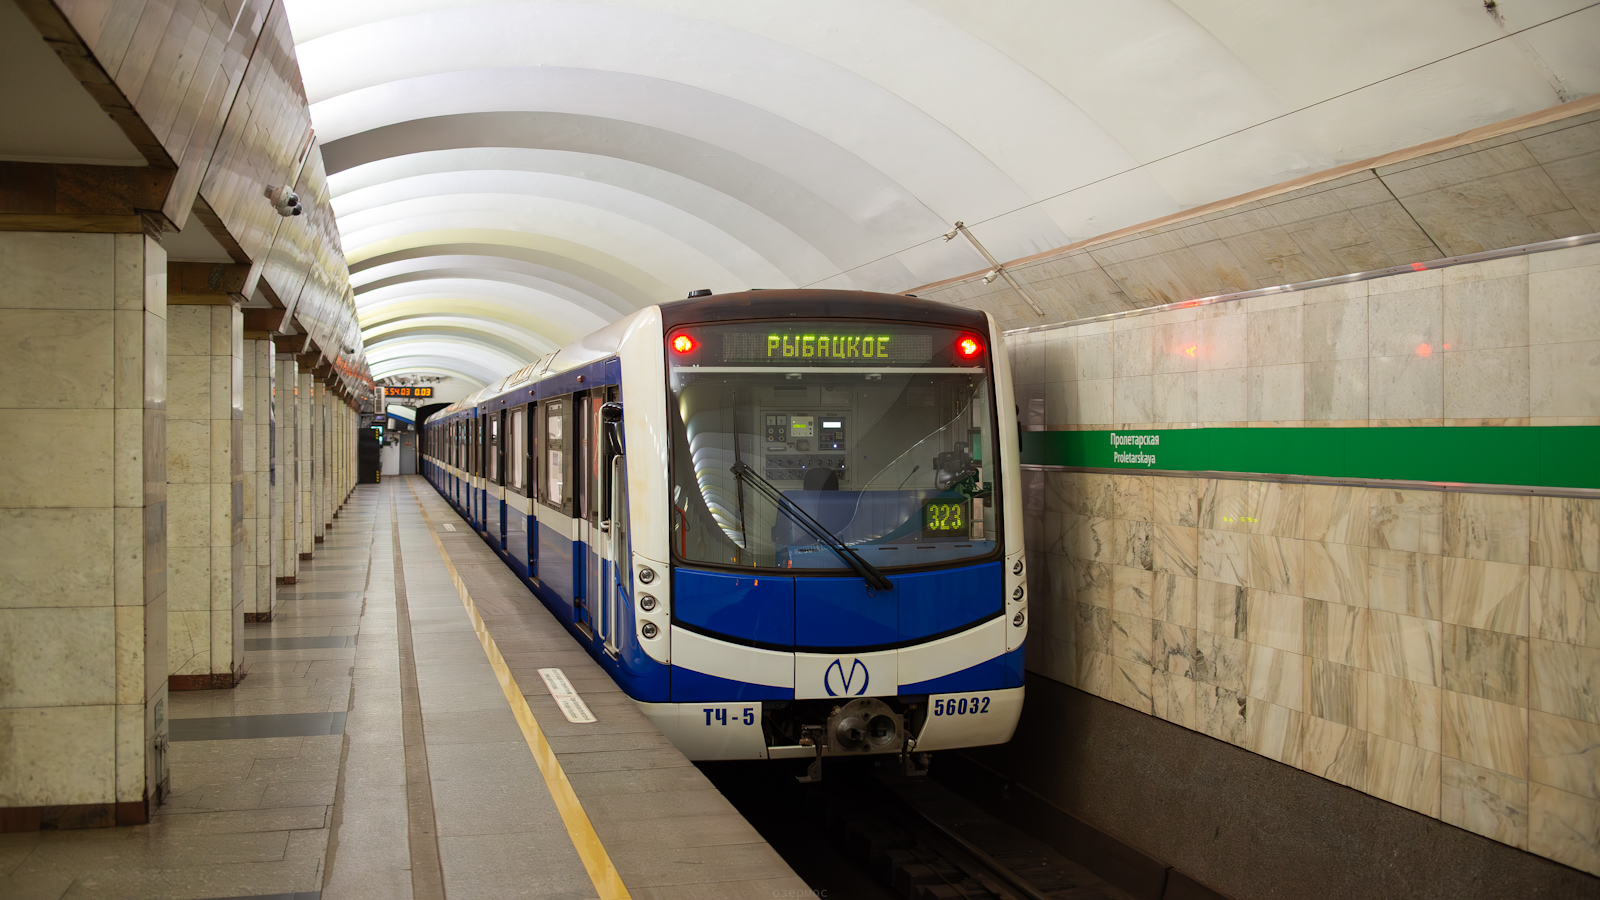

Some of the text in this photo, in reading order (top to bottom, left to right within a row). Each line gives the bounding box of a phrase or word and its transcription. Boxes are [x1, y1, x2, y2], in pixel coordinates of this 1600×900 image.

[767, 335, 890, 358] РЫБАЦКОЕ
[1110, 432, 1160, 449] Пролетарская
[1113, 450, 1156, 467] Proletarskaya
[929, 503, 962, 531] 323
[934, 696, 991, 716] 56032
